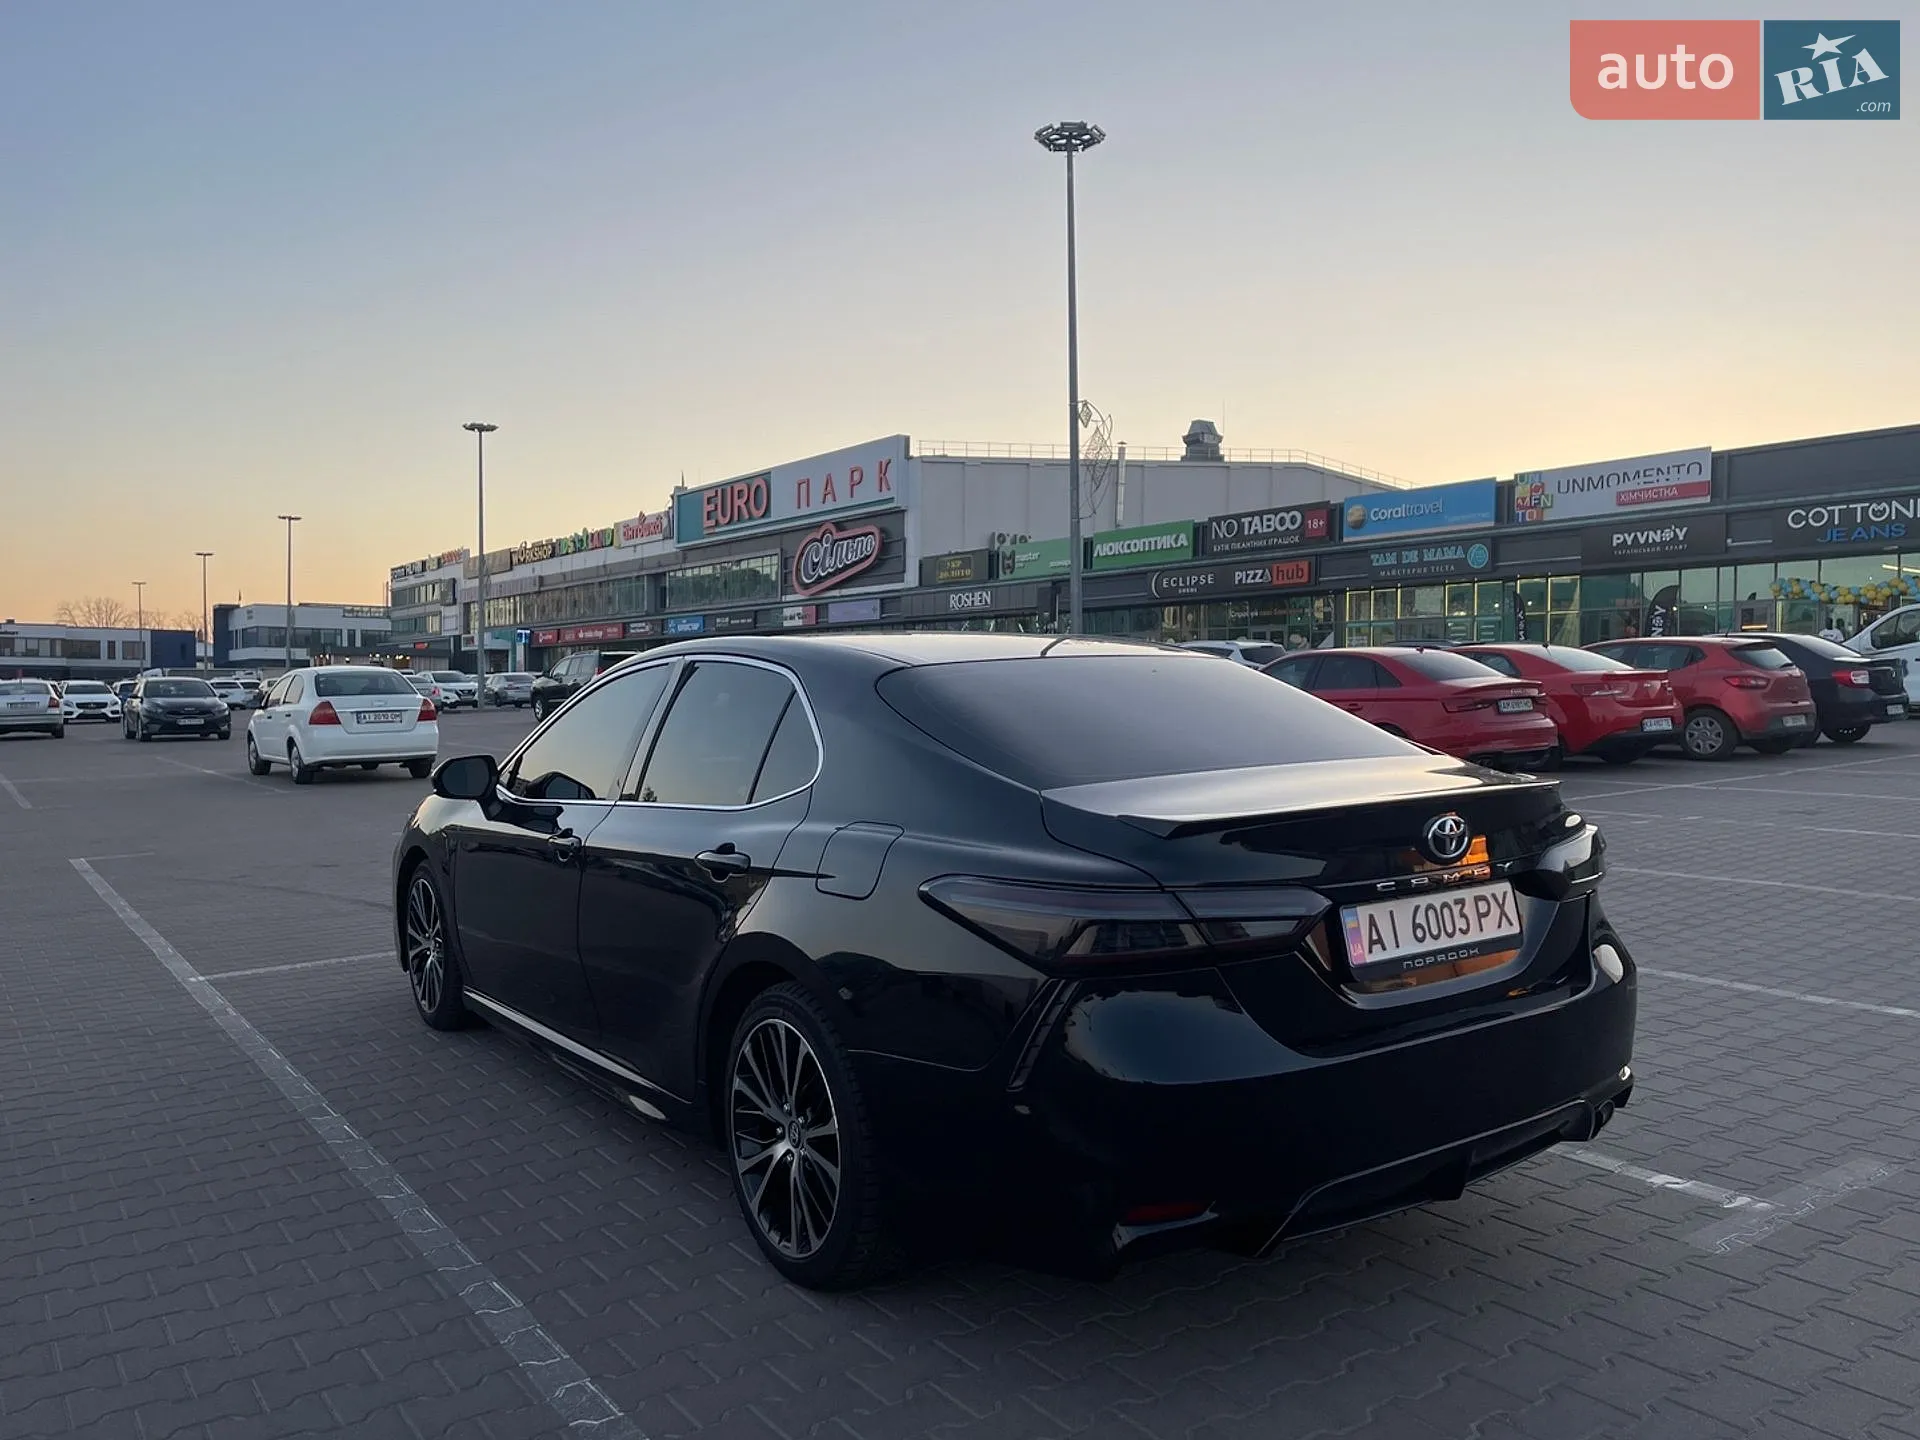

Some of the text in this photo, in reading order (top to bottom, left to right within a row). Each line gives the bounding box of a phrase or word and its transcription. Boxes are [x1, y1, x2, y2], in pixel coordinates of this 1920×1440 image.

[703, 458, 892, 529] EURO ПАРК
[1619, 486, 1679, 502] ХІМЧИСТКА
[1307, 518, 1325, 529] 18+
[1787, 498, 1920, 529] COTTON
[1211, 511, 1302, 540] NO TABOO
[1817, 523, 1906, 543] JEANS
[1162, 573, 1215, 588] ECLIPSE
[1234, 565, 1304, 585] PIZZA hub
[950, 591, 991, 611] ROSHEN
[1367, 890, 1515, 954] AI 6003 PX
